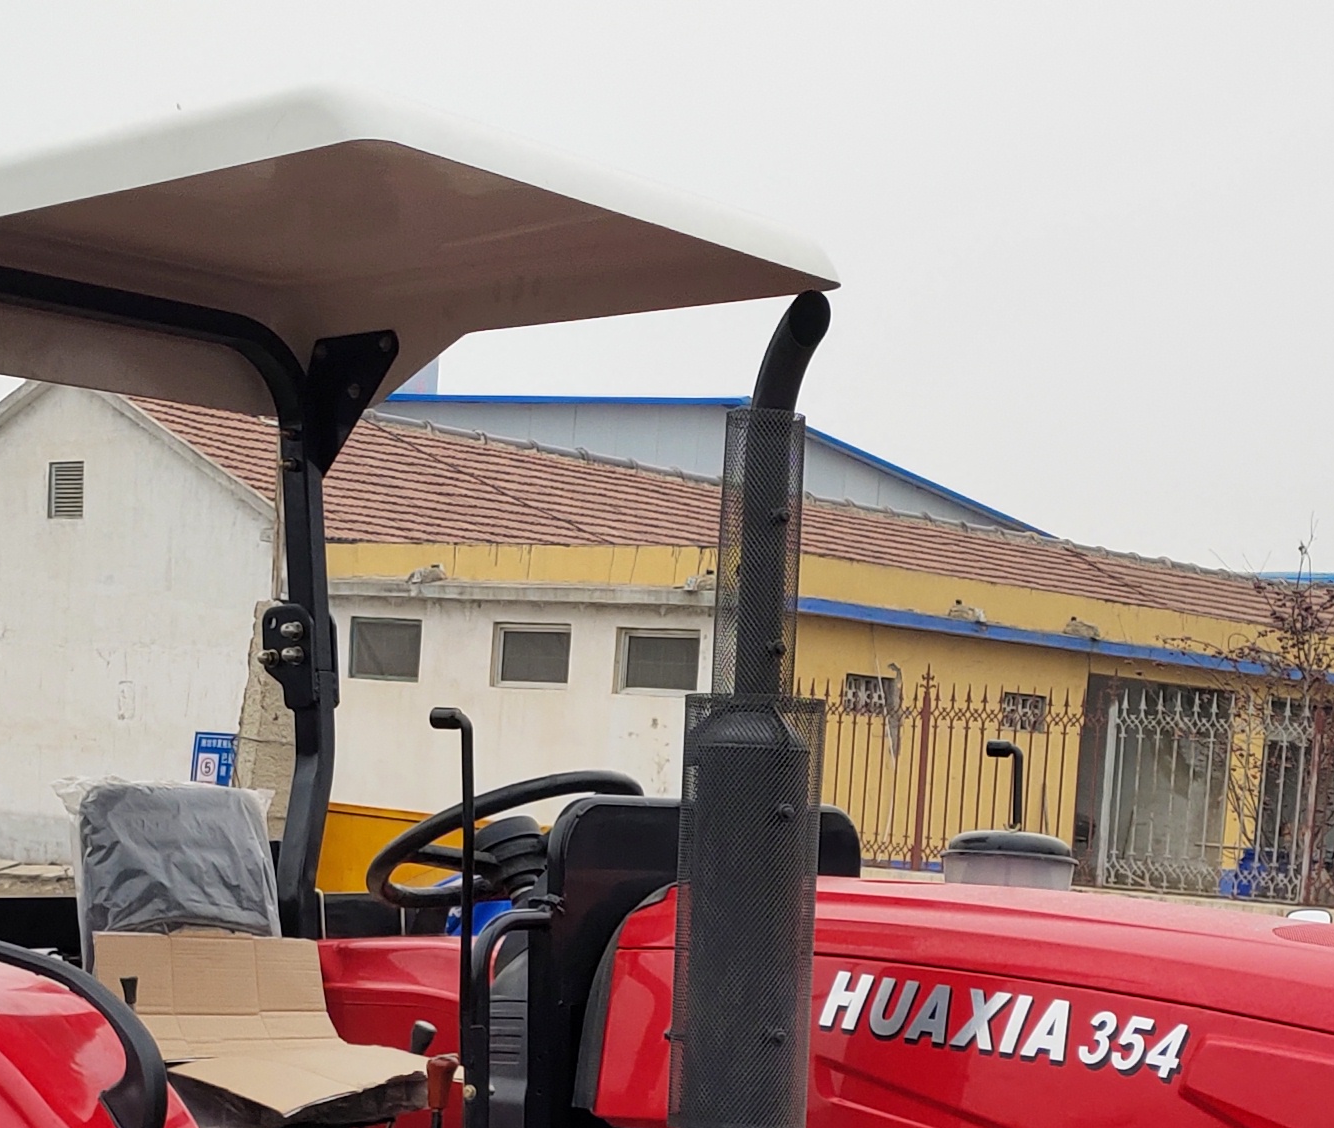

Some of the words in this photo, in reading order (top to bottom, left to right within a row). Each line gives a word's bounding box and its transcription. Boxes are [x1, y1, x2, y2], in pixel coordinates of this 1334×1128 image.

[204, 761, 212, 774] 5
[818, 971, 1071, 1064] HUAXIA
[1078, 1011, 1189, 1081] 354
